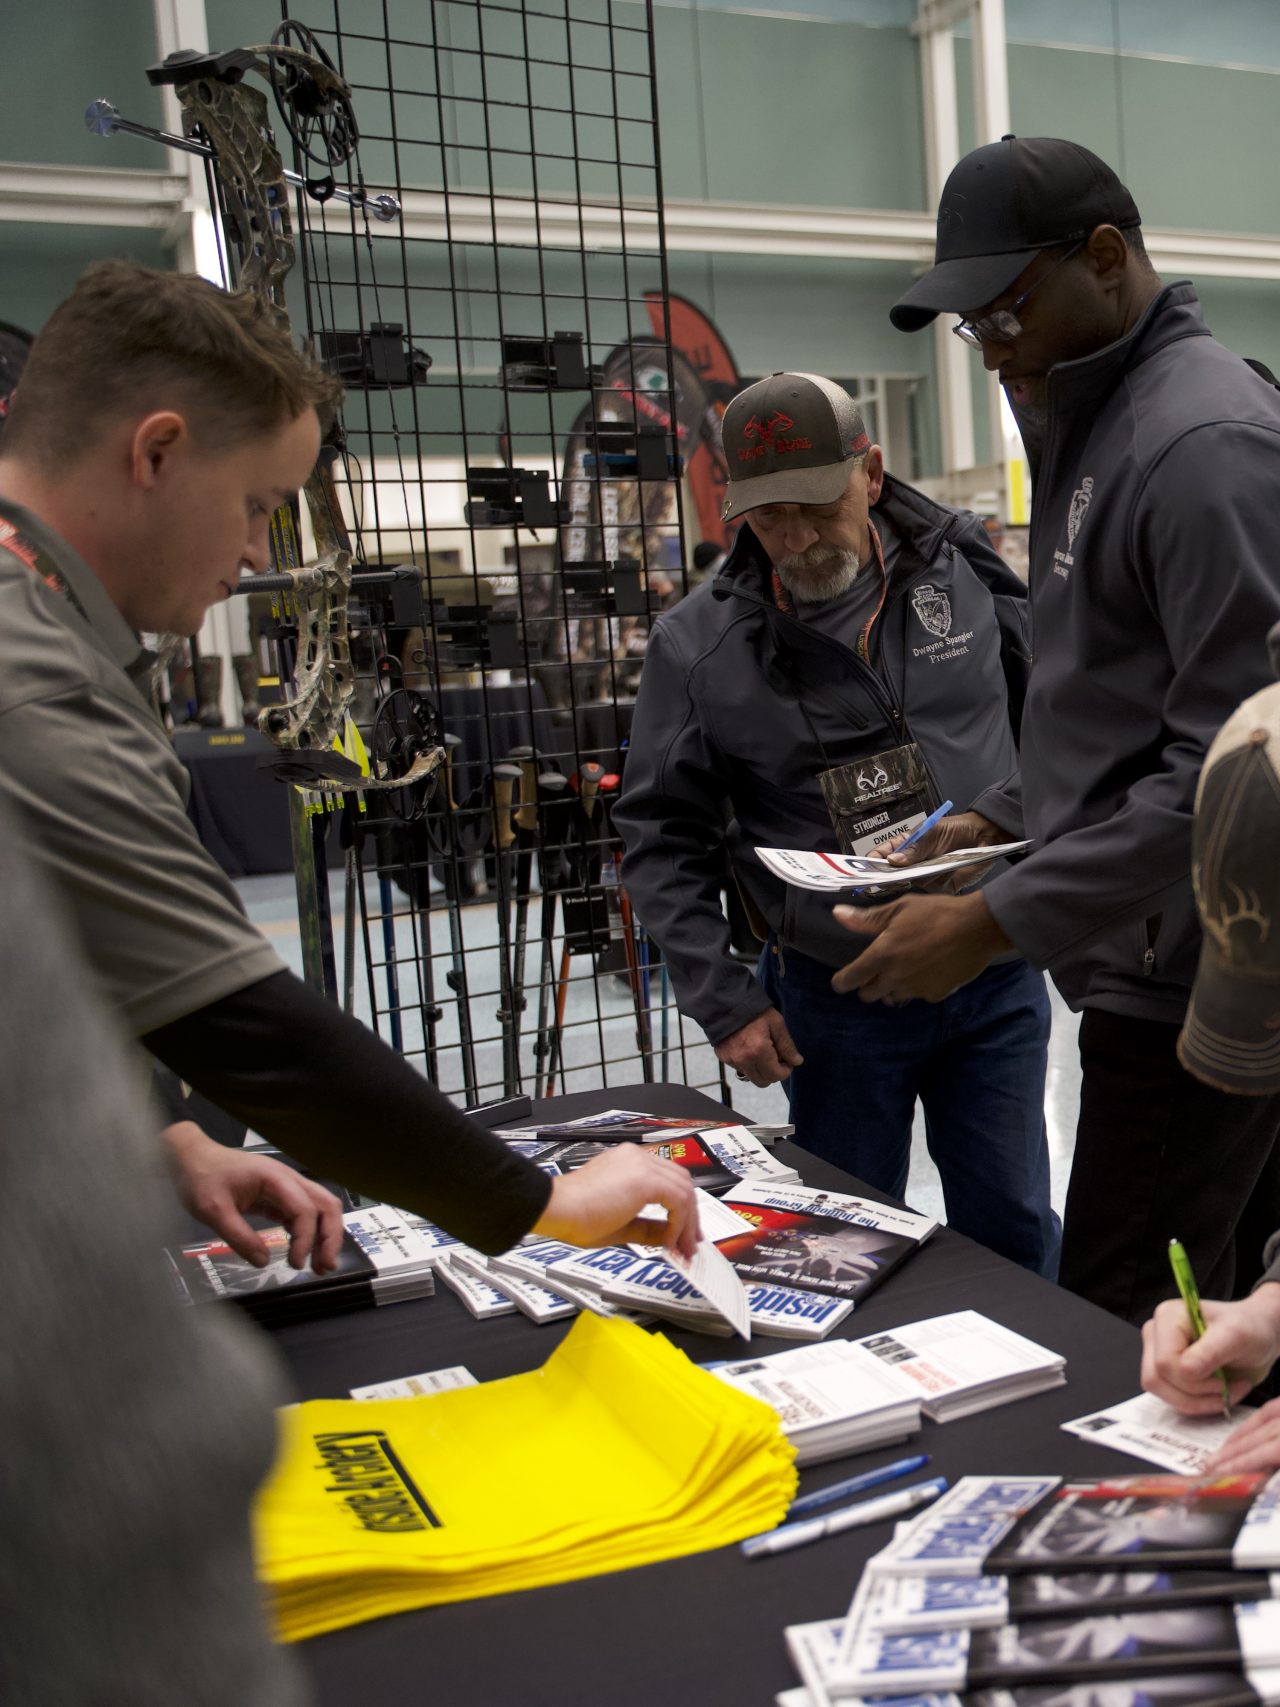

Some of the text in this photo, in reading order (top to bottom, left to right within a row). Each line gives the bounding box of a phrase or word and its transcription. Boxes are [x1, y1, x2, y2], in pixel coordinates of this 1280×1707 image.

[912, 630, 974, 657] Dwayne Spangler
[929, 645, 970, 664] President
[854, 783, 901, 804] REALTREE
[853, 811, 890, 835] STRONGER
[873, 824, 910, 846] DWAYNE
[764, 1196, 802, 1212] Group
[857, 1214, 880, 1230] The
[748, 1285, 841, 1324] Inside
